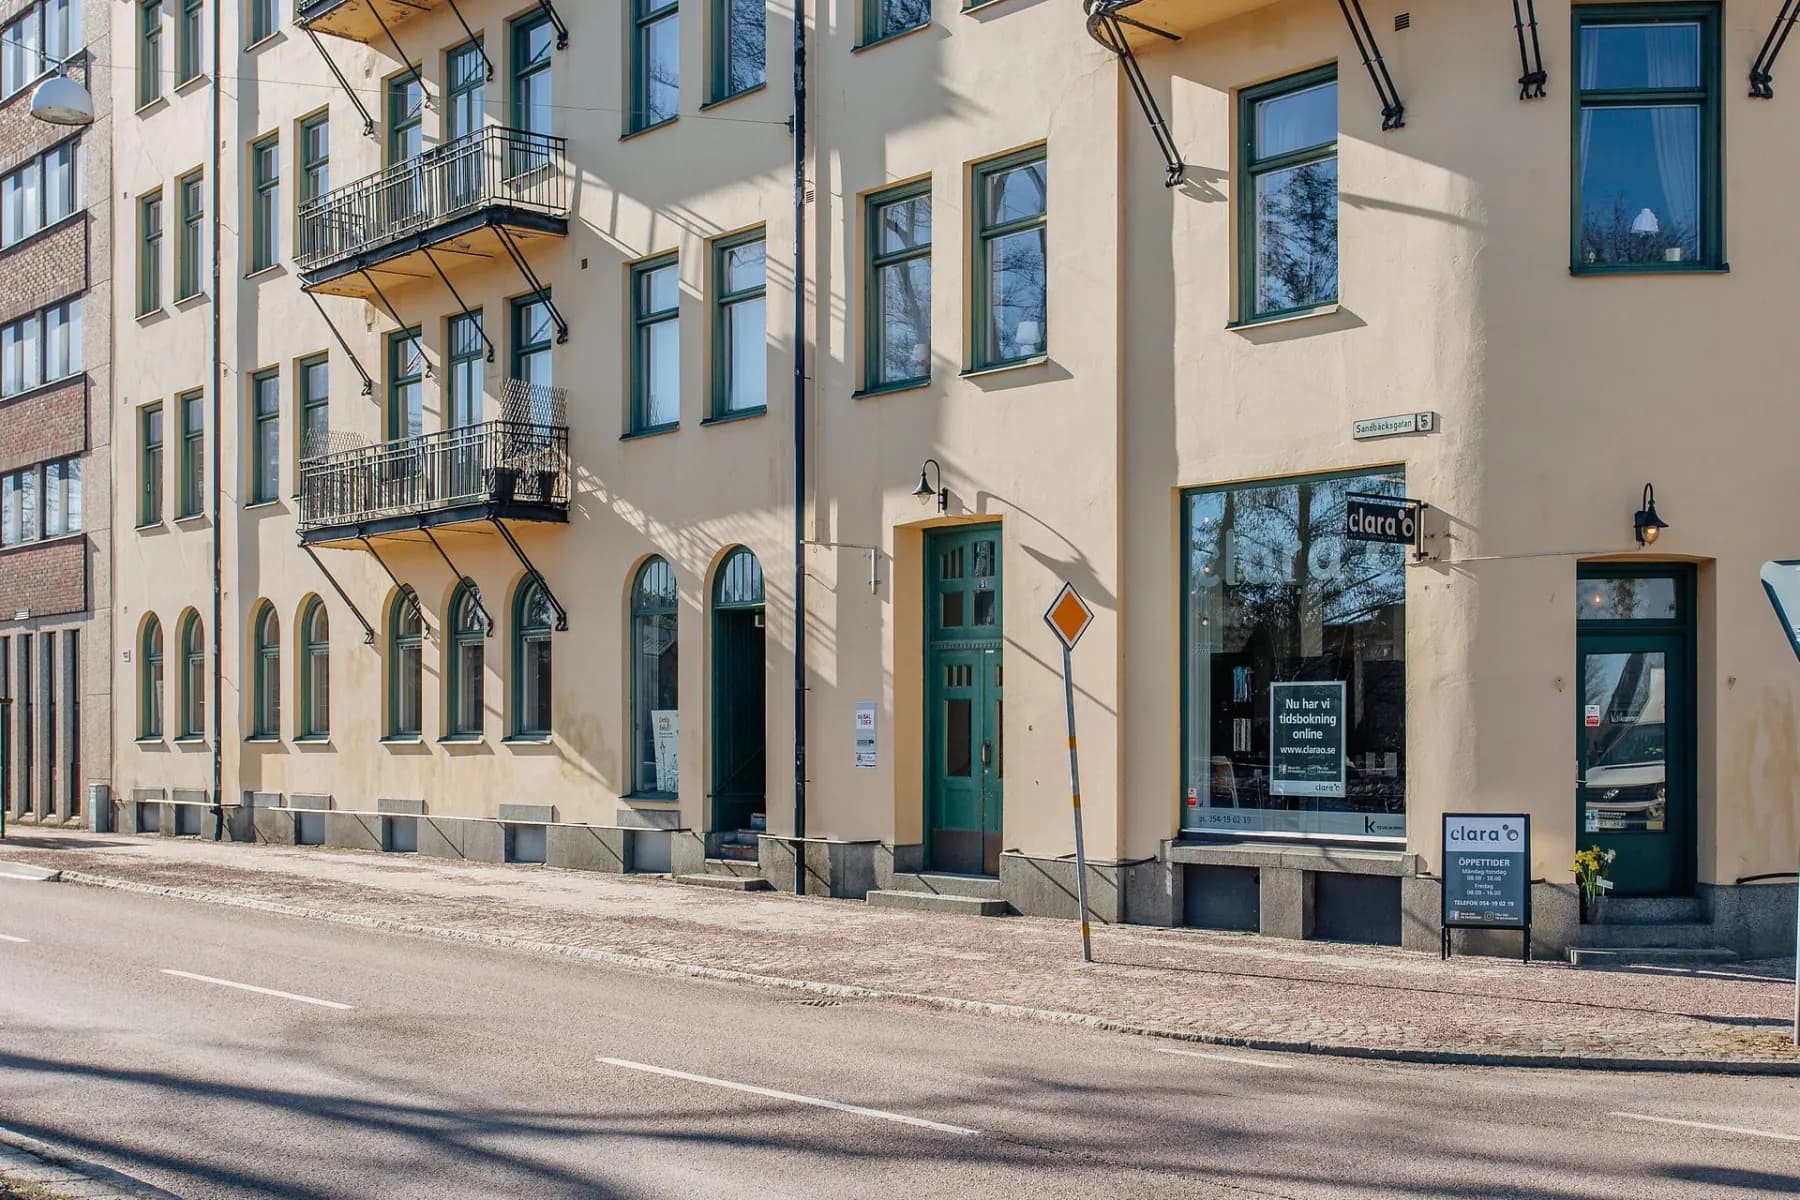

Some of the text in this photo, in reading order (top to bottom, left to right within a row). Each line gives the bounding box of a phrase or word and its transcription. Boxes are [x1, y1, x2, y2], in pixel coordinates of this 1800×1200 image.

[1356, 414, 1428, 433] Sandbäcksgatan 5
[1349, 507, 1397, 535] clara
[1286, 697, 1330, 709] Nu har vi
[1279, 713, 1337, 727] tidsbokning
[1292, 728, 1323, 739] online
[1280, 745, 1336, 754] www.clarao.se
[1450, 825, 1500, 841] clara
[1458, 857, 1511, 867] ÖPPETTIDER
